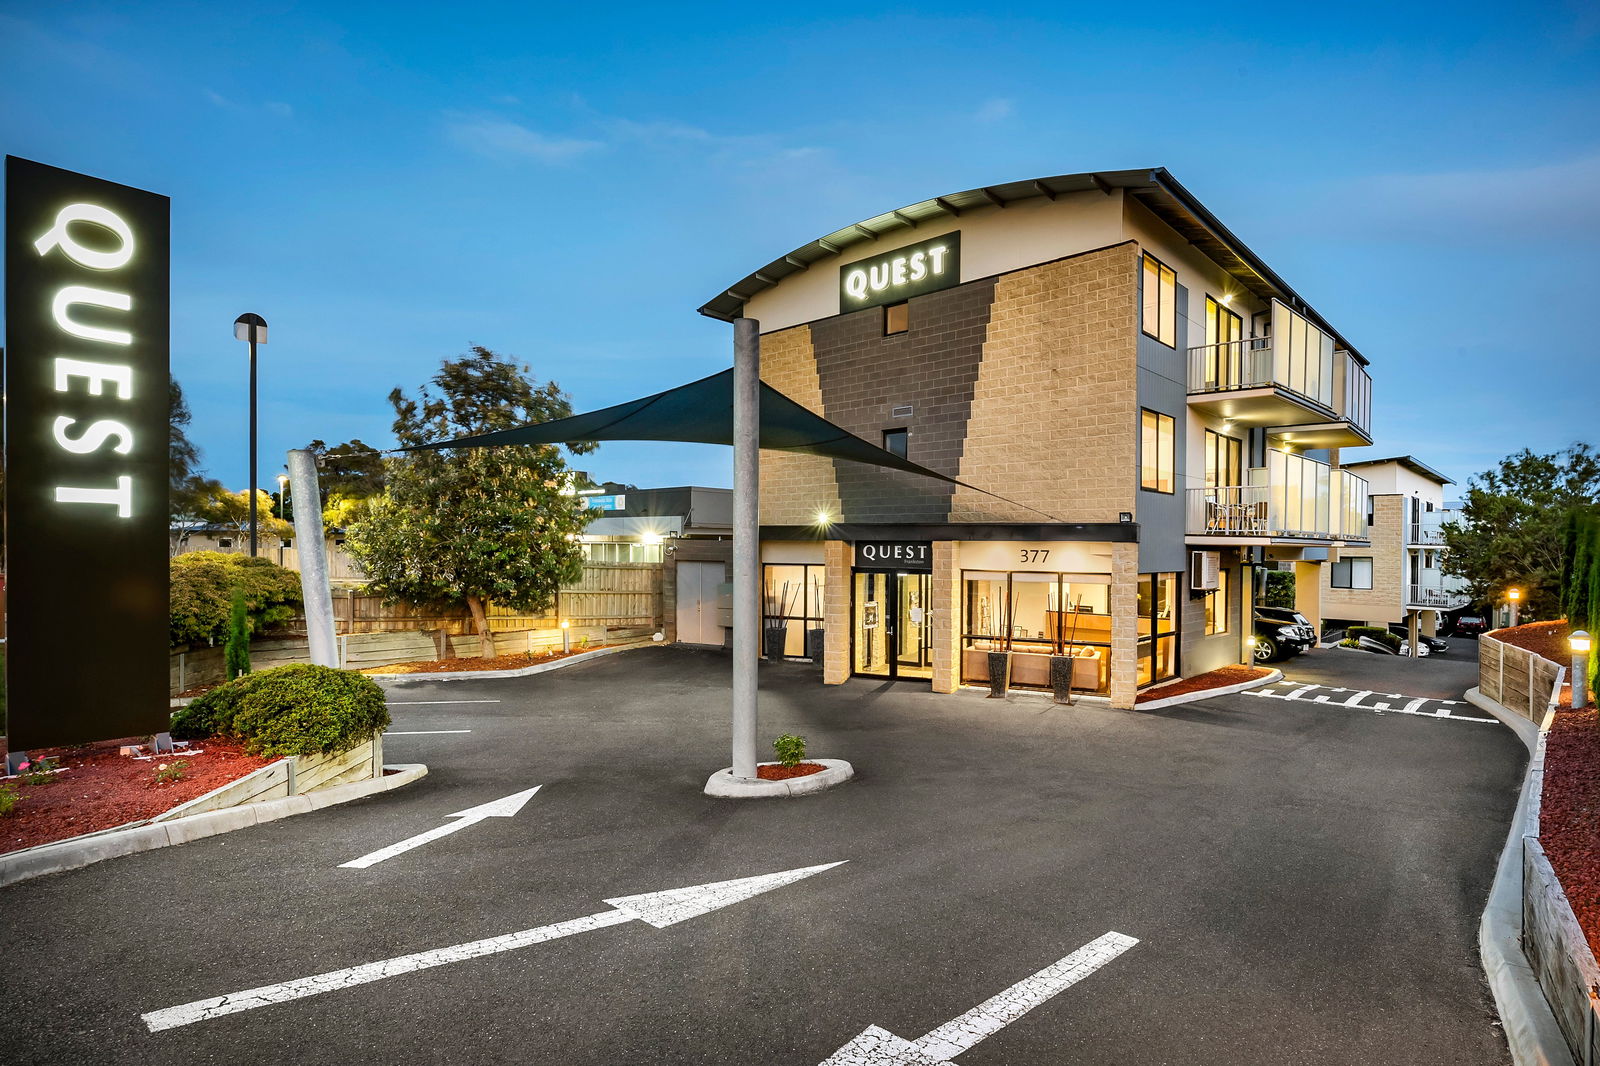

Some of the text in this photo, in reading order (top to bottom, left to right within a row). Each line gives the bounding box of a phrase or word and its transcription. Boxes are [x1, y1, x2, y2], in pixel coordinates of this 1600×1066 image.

[846, 246, 948, 300] QUEST
[34, 202, 134, 518] QUEST
[862, 544, 927, 561] QUEST
[1020, 549, 1050, 564] 377
